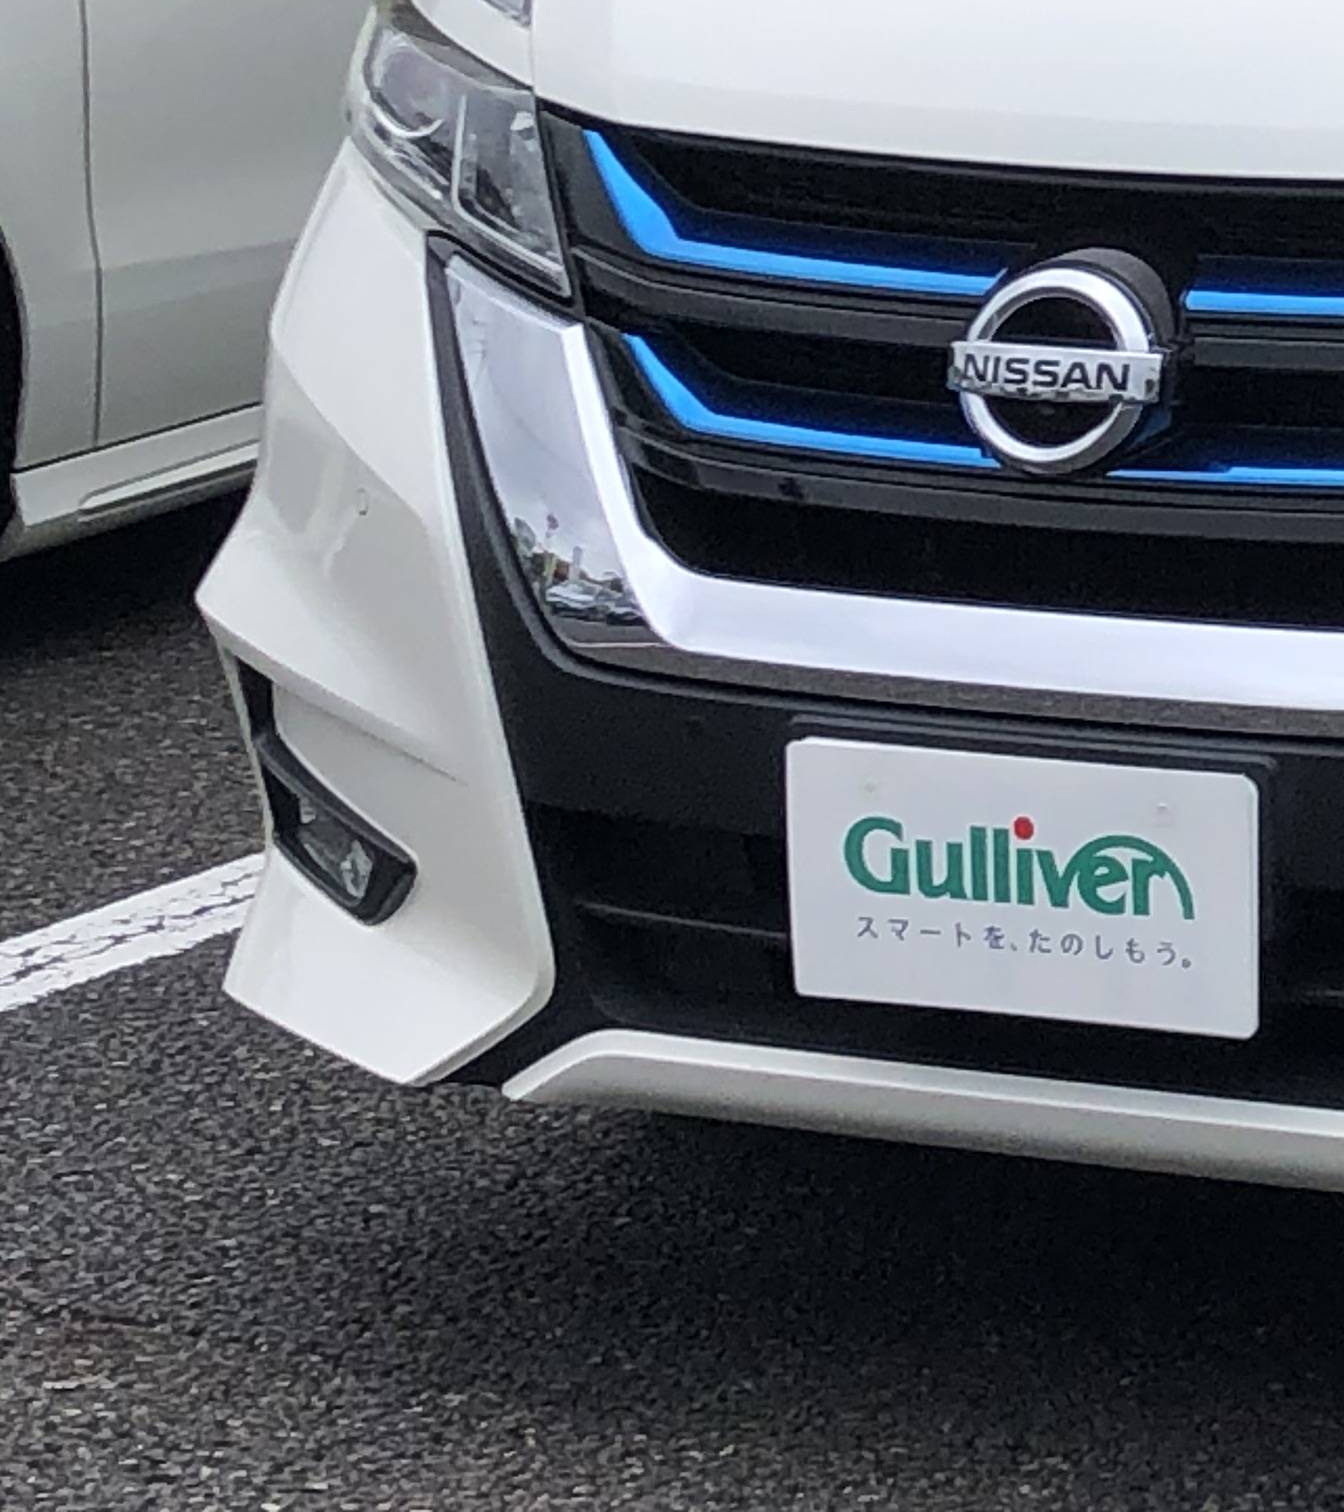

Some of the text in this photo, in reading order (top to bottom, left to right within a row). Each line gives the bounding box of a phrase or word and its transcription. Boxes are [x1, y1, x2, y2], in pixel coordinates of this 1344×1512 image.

[963, 352, 1131, 392] NISSAN
[843, 815, 1196, 920] Gulliver
[856, 915, 1193, 970] スマートを、たのしもう。
